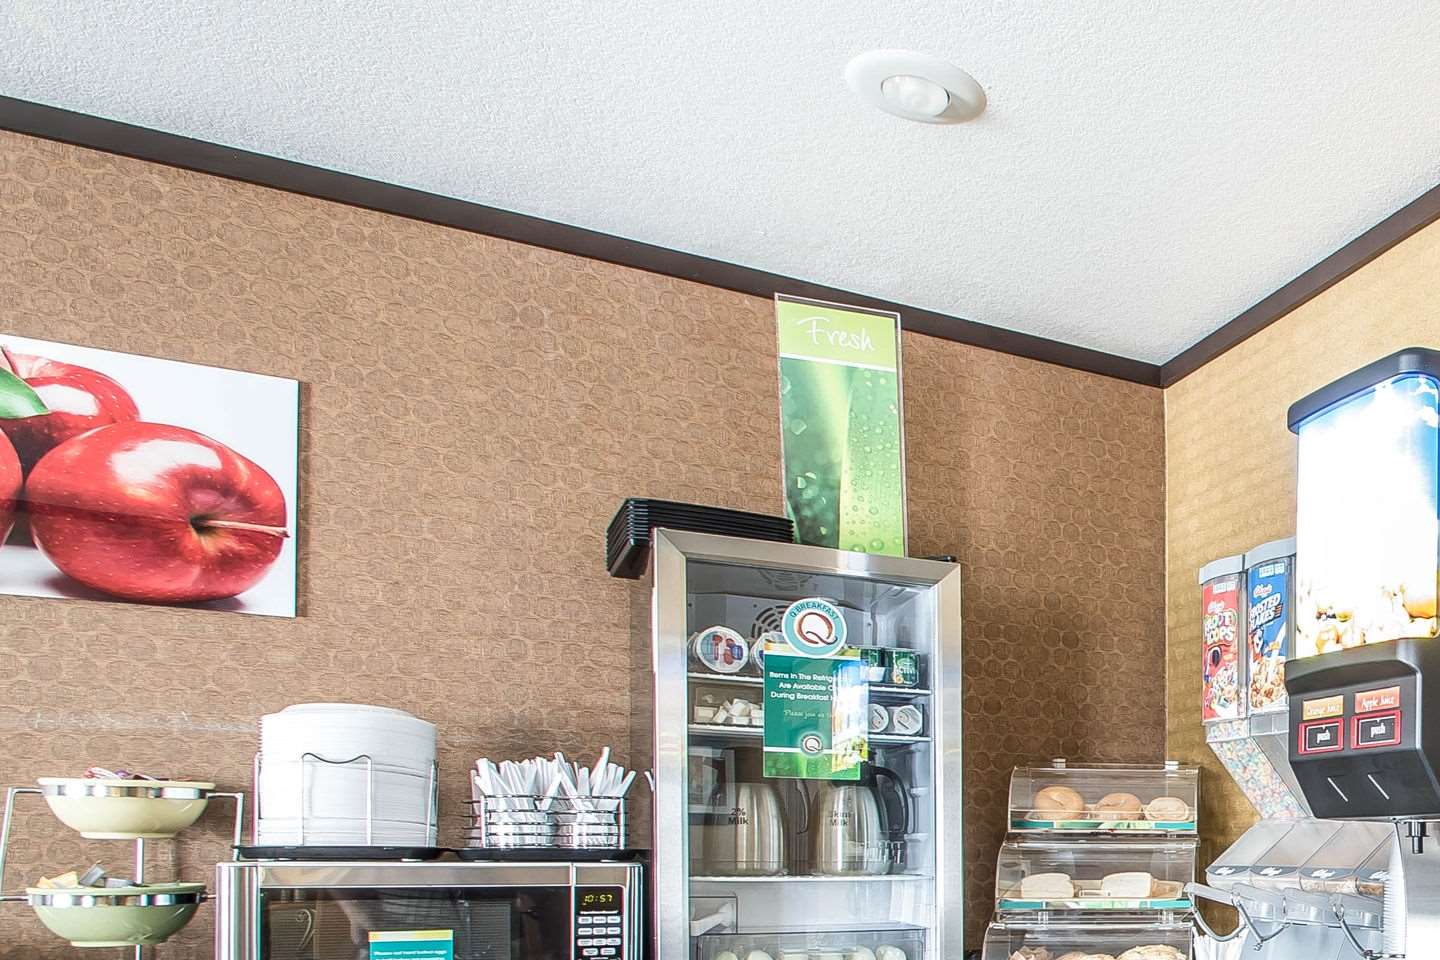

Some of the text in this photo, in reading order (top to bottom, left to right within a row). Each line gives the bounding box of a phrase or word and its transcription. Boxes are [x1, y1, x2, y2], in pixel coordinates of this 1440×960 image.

[795, 315, 876, 352] Fresh
[769, 671, 789, 679] Items
[793, 683, 826, 691] Available
[770, 691, 796, 700] During
[796, 692, 829, 701] Breakfast
[1361, 697, 1380, 712] Apple
[1370, 722, 1386, 738] push
[727, 817, 750, 825] Milk
